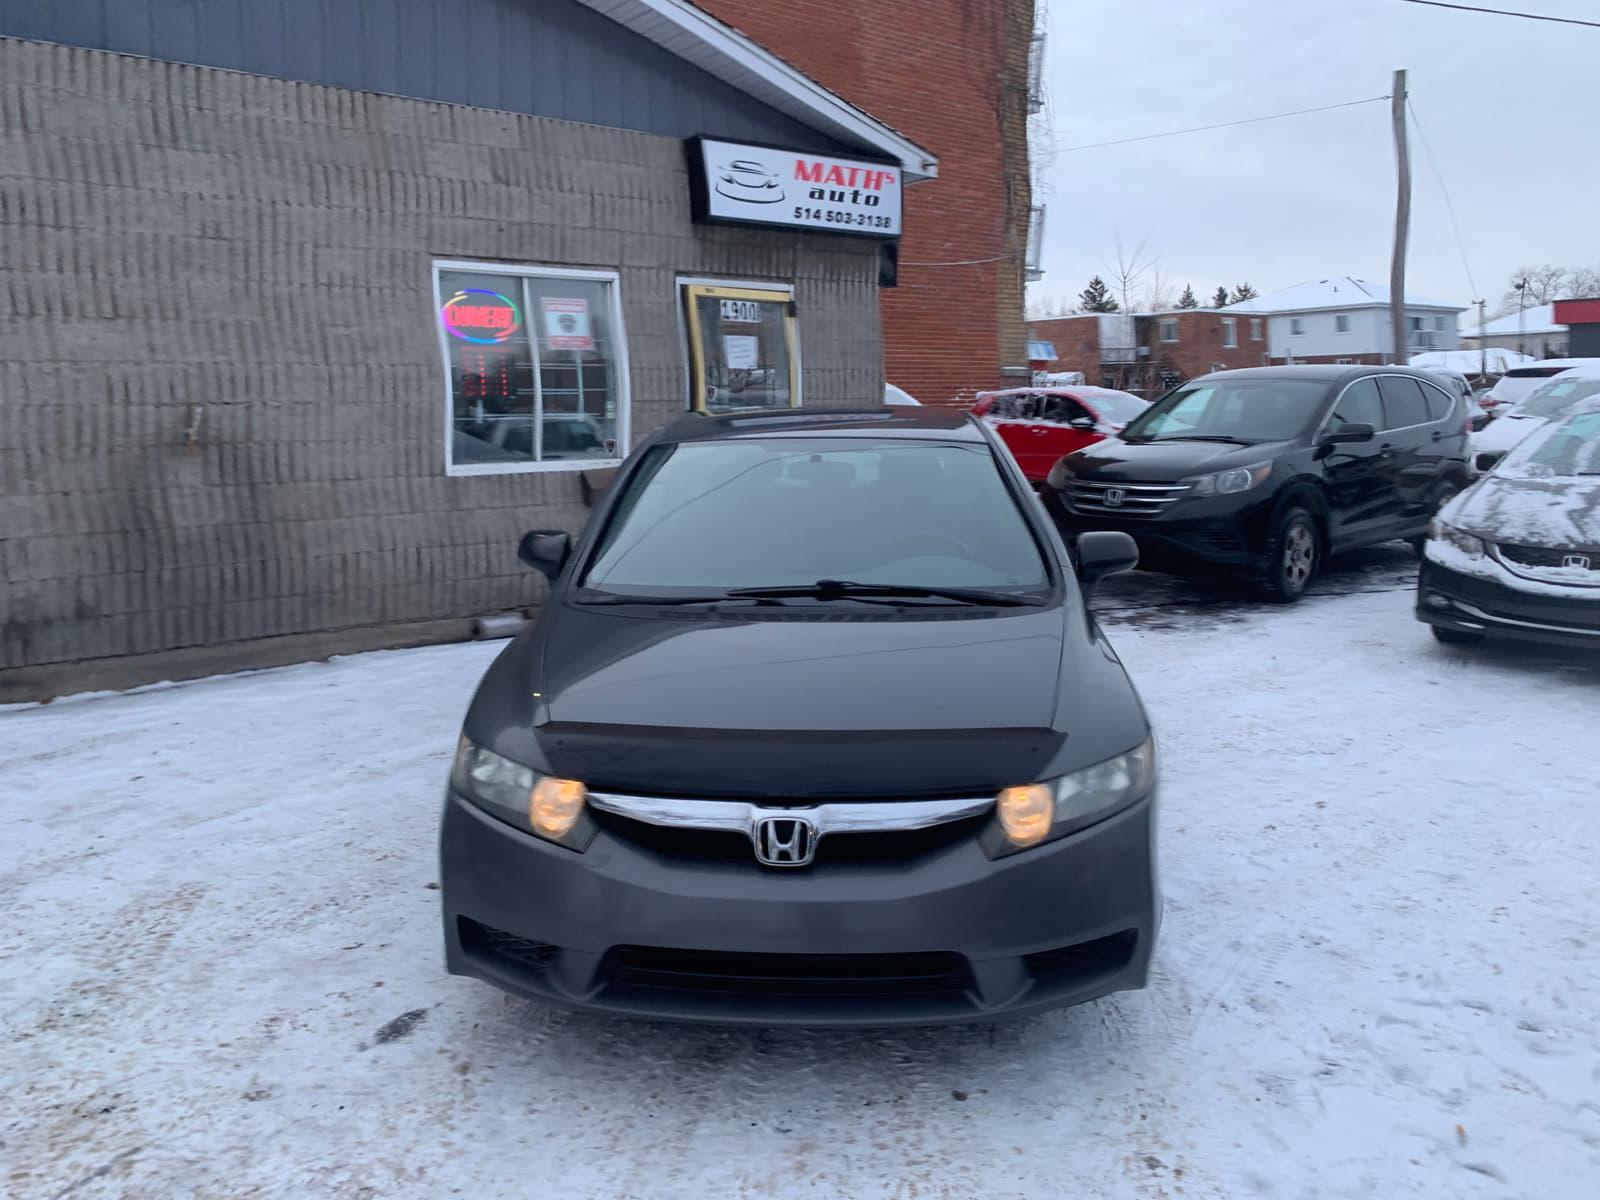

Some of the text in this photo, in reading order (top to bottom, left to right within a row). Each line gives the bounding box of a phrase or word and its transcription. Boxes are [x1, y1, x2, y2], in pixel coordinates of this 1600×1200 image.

[809, 187, 880, 206] auto
[794, 206, 892, 228] 514 503-3138
